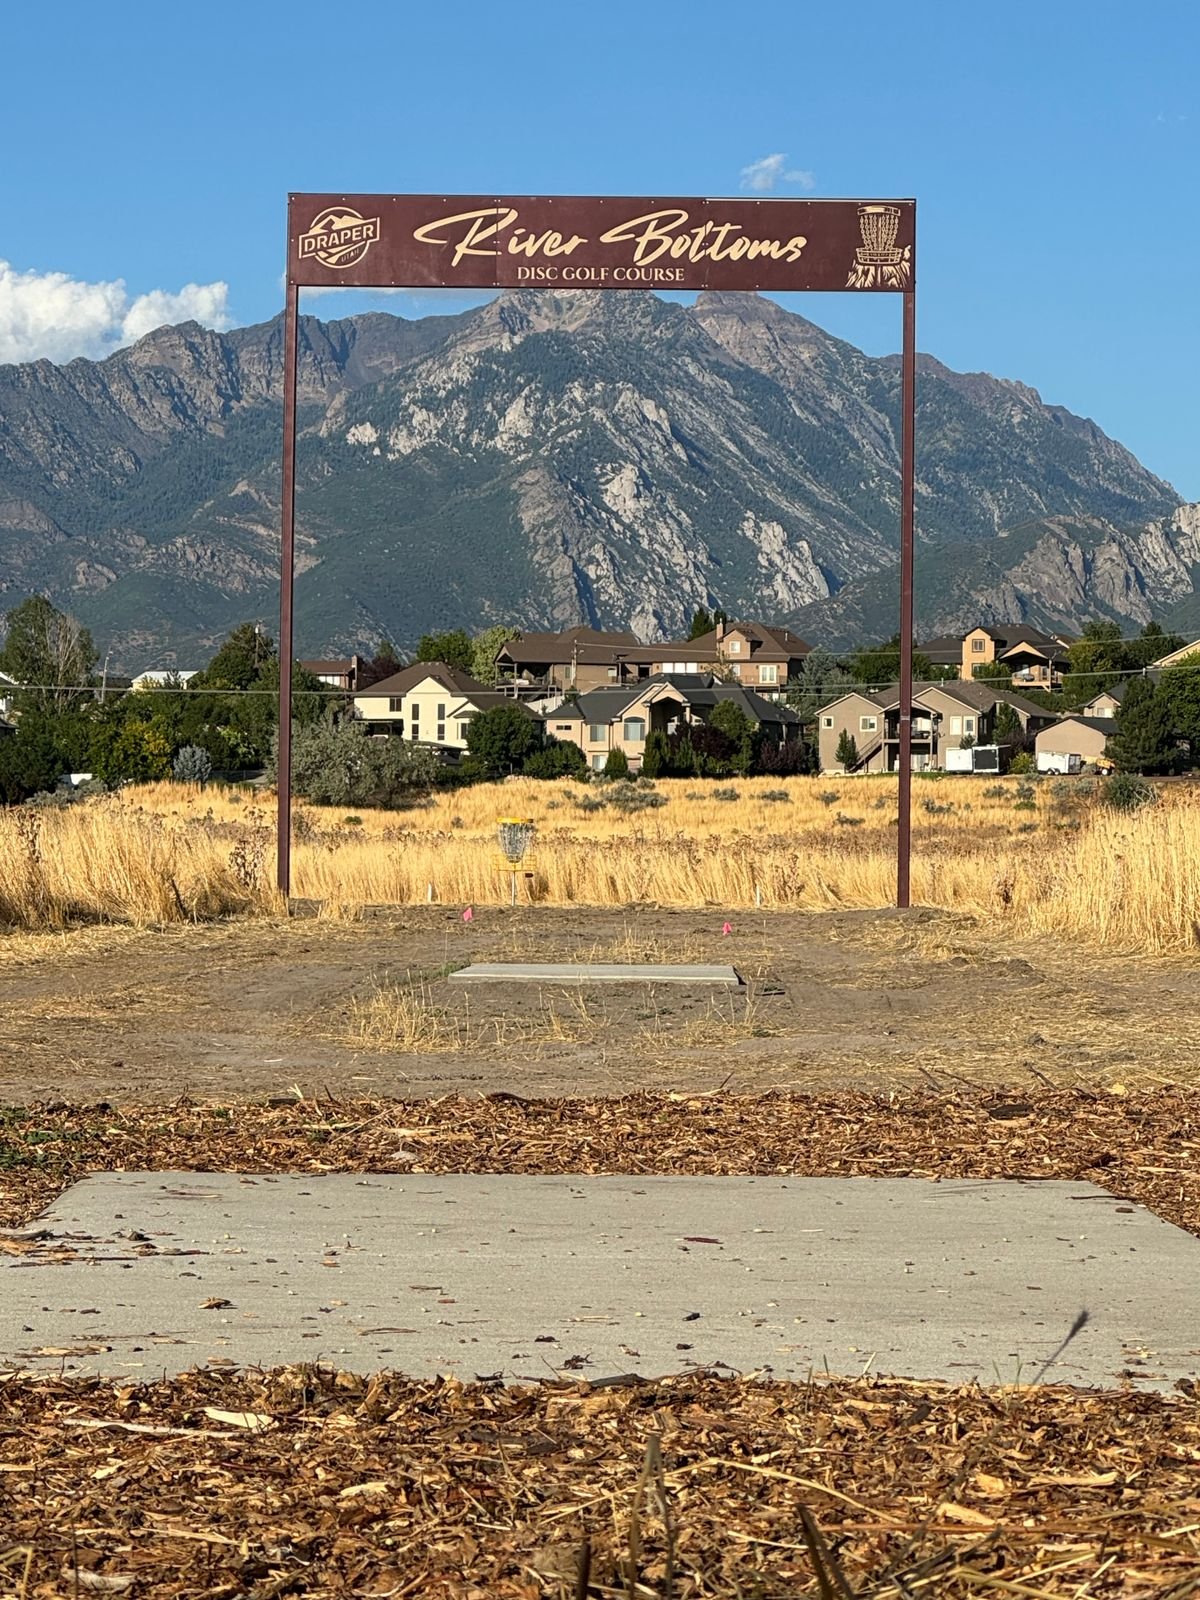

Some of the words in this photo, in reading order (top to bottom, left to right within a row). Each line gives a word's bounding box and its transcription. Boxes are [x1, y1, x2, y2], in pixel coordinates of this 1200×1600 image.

[304, 224, 374, 252] DRAPER
[413, 207, 588, 267] River
[600, 209, 807, 266] Bottoms
[517, 267, 557, 280] DISC
[562, 267, 609, 280] GOLF
[613, 267, 685, 281] COURSE
